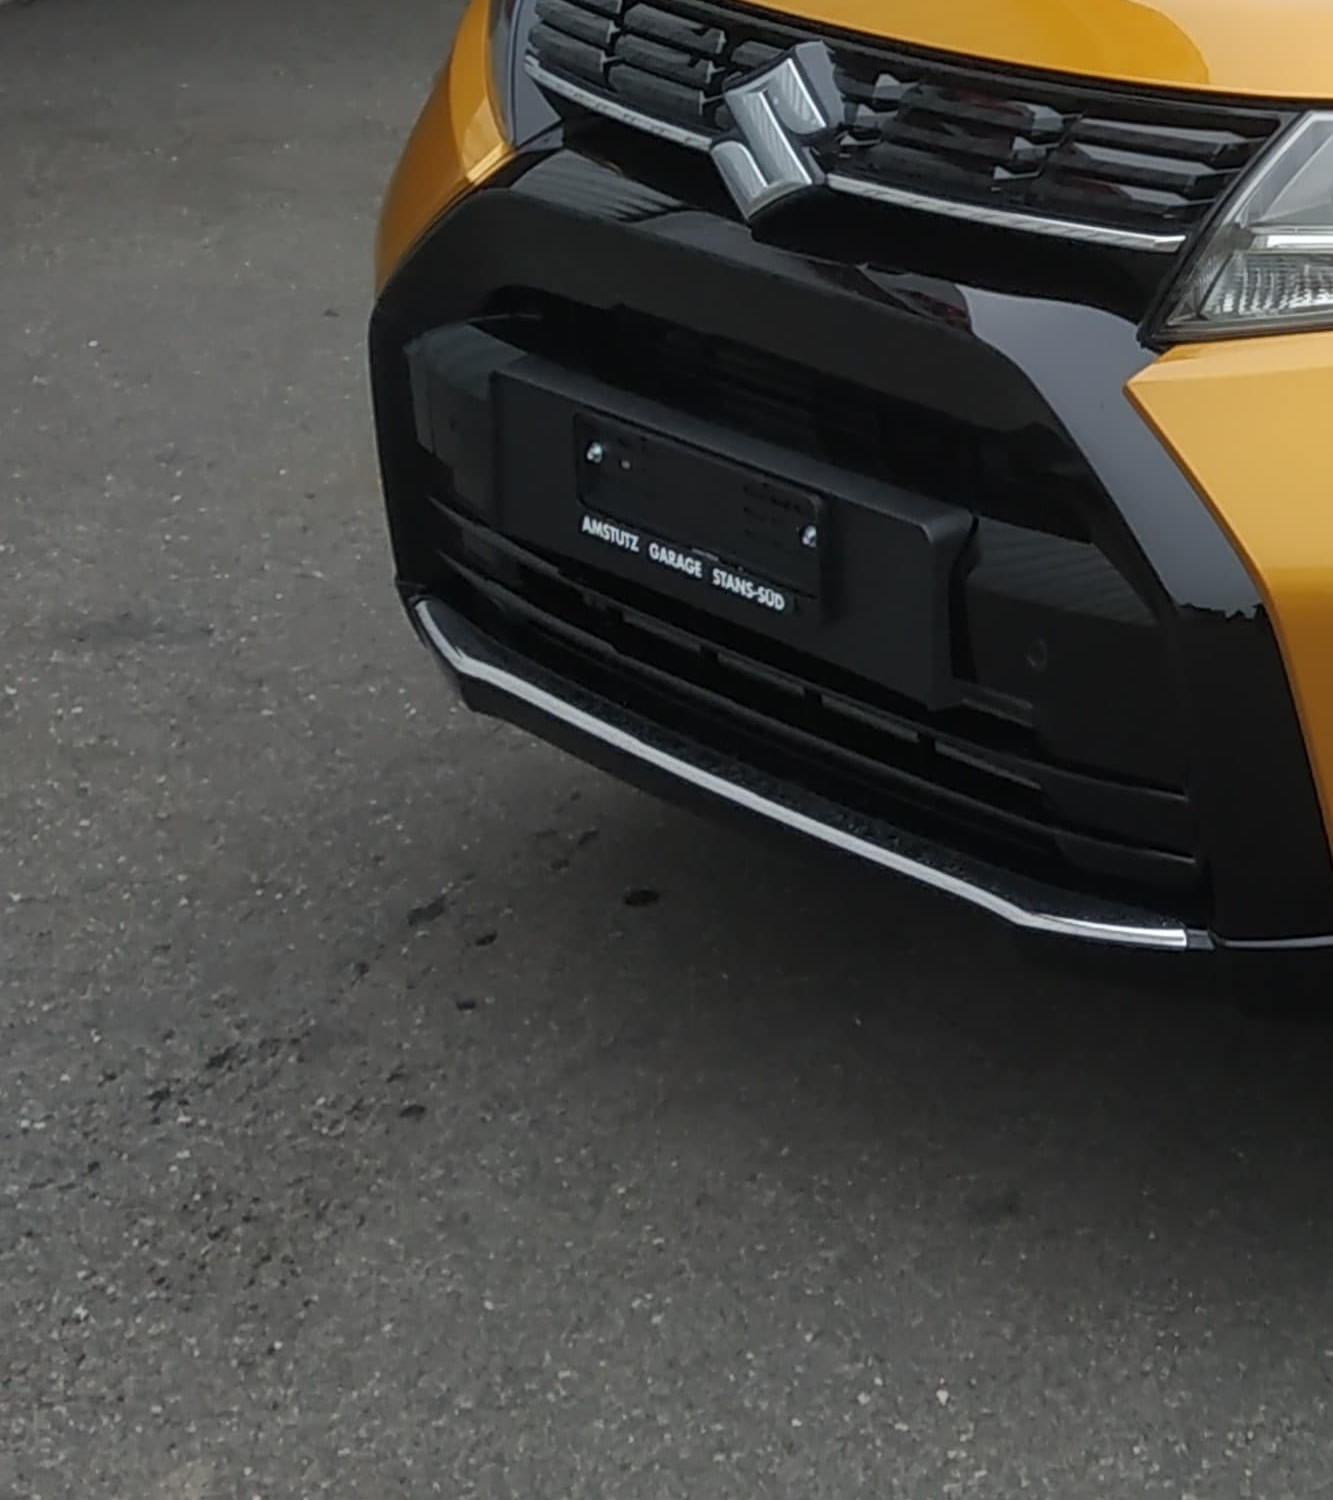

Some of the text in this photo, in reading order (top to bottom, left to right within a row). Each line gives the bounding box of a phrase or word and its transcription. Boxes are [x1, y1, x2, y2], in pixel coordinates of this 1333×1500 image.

[581, 515, 786, 612] AMSTUTZ GARAGE STANS-SÜD
